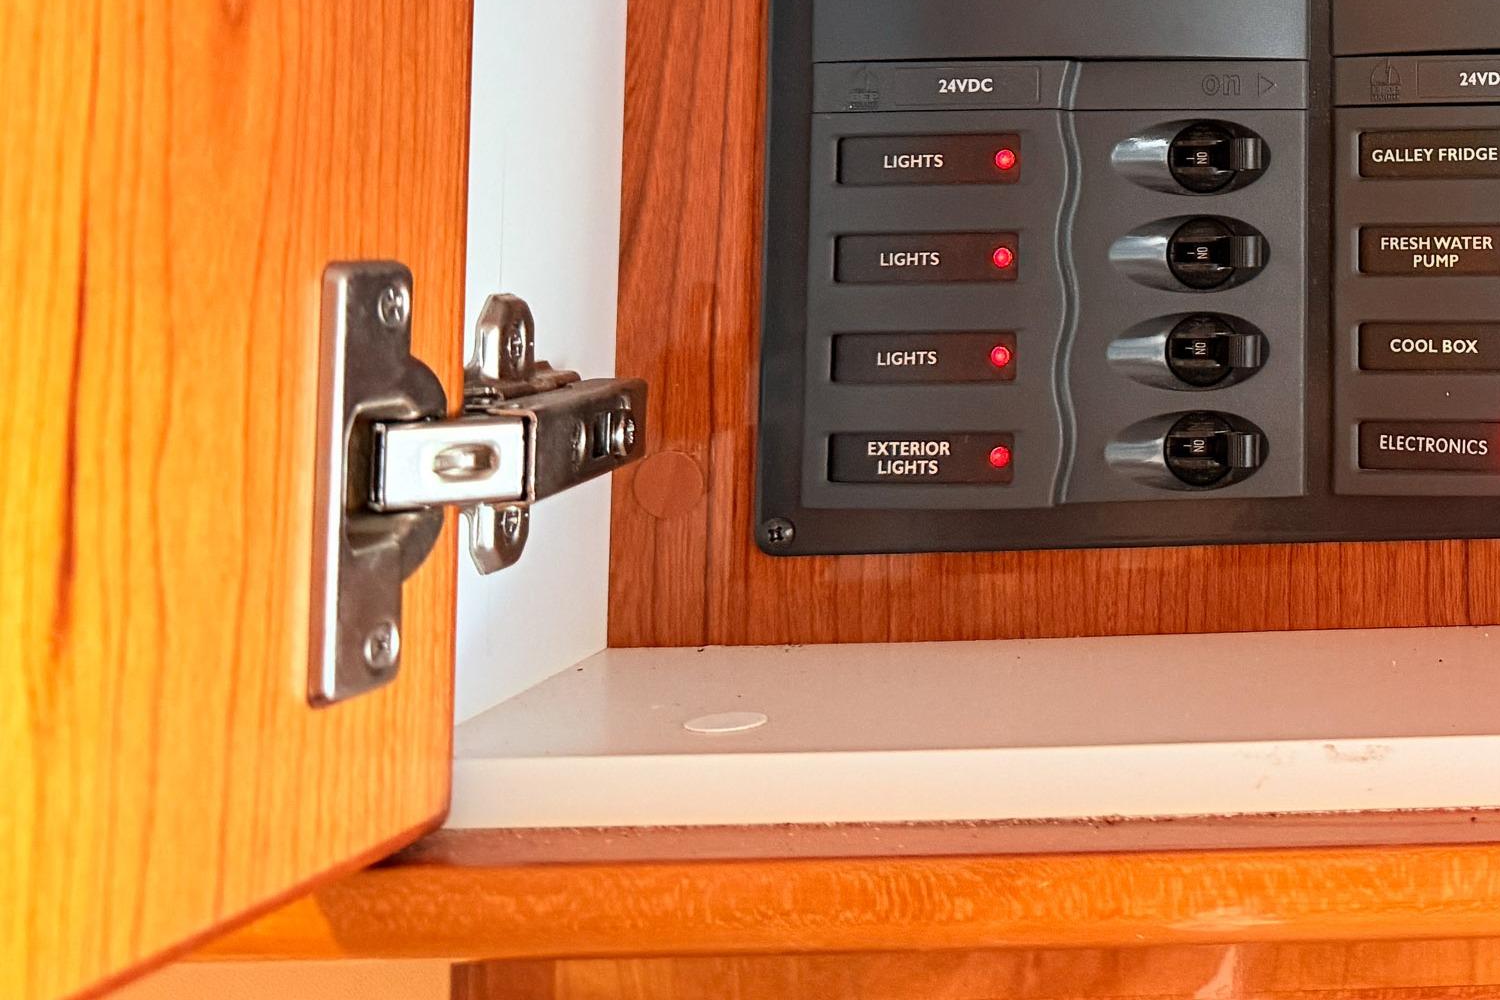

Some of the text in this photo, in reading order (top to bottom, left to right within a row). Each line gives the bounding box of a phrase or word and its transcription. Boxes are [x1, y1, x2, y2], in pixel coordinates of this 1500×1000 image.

[938, 79, 993, 93] 24VDC
[1202, 73, 1241, 96] on
[883, 154, 944, 169] LIGHTS
[1372, 147, 1498, 162] GALLEY FRIDGE
[1380, 236, 1493, 251] FRESH WATER
[880, 252, 940, 267] LIGHTS
[1413, 254, 1460, 268] PUMP
[1390, 338, 1478, 354] COOL BOX
[877, 352, 938, 366] LIGHTS
[867, 441, 951, 456] EXTERIOR
[1379, 435, 1488, 456] ELECTRONICS
[877, 461, 939, 475] LIGHTS
